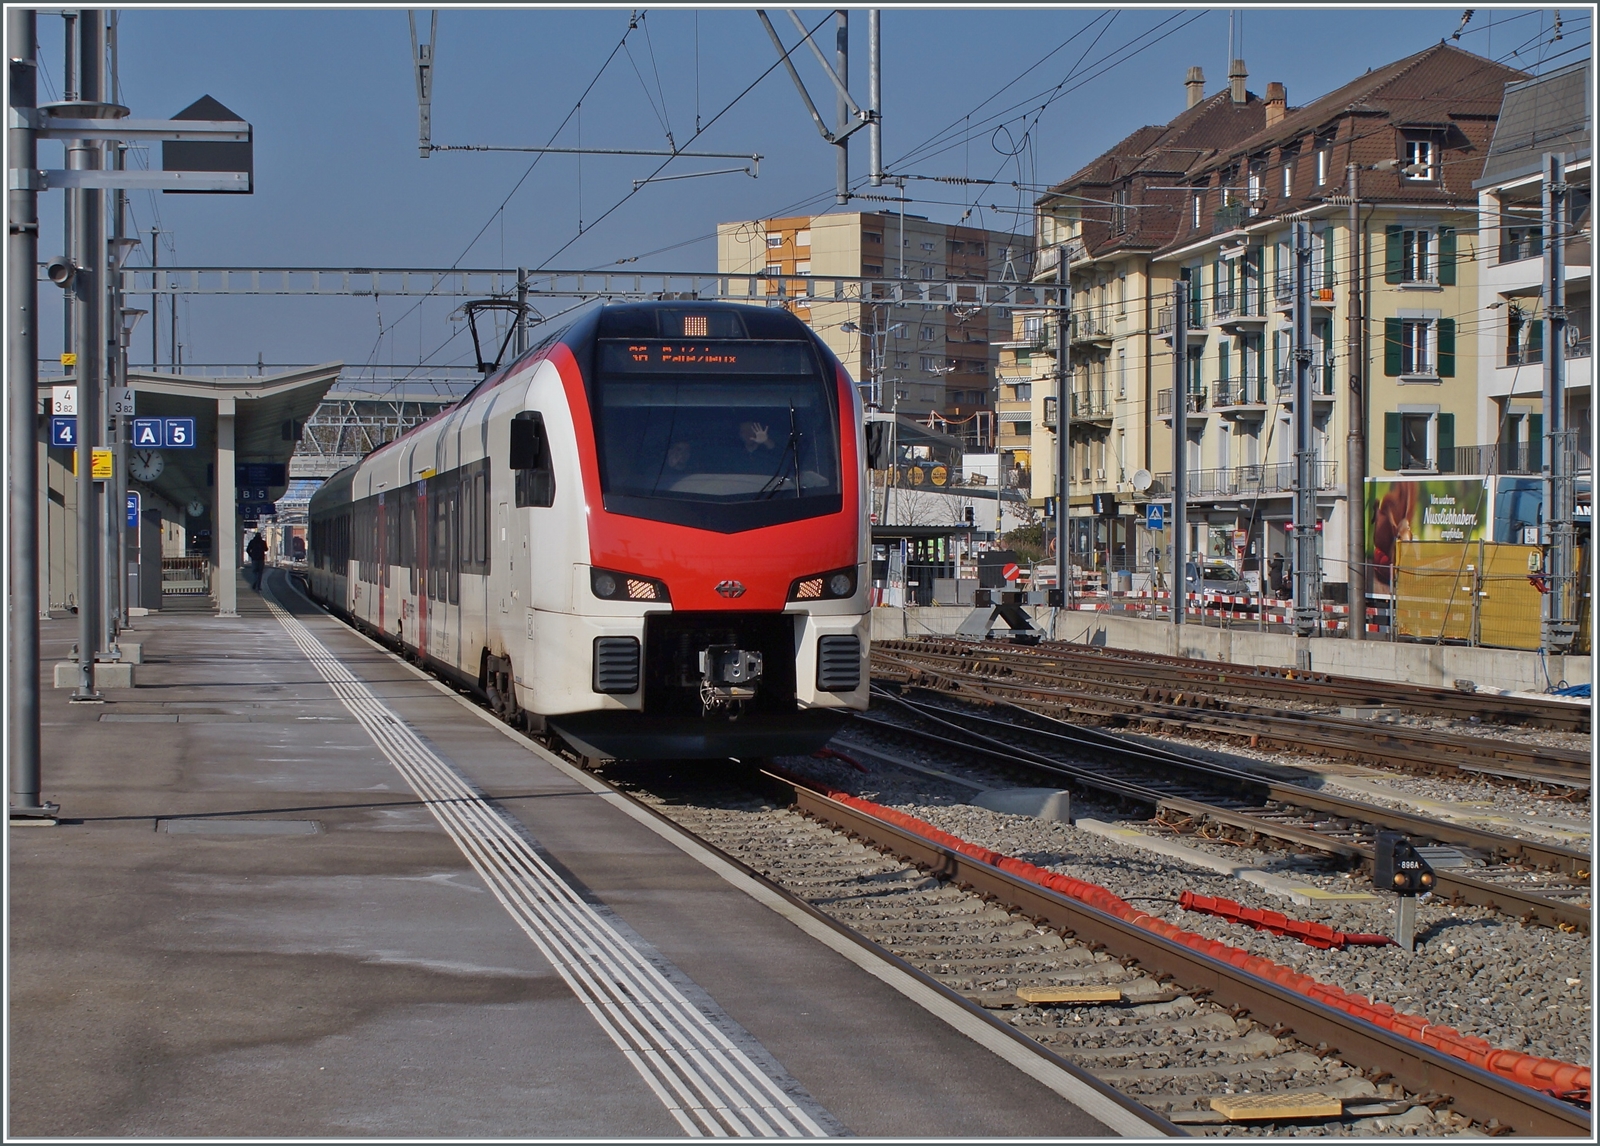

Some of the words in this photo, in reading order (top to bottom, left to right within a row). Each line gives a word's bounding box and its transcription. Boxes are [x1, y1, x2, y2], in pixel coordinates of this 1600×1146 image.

[64, 390, 71, 400] 4
[124, 390, 131, 400] 4
[55, 402, 62, 412] 3
[115, 402, 122, 412] 3
[60, 426, 73, 442] 4
[140, 427, 156, 443] A
[173, 427, 186, 443] 5
[243, 490, 250, 498] B
[258, 490, 264, 498] 5
[1430, 493, 1438, 504] Von
[1439, 494, 1456, 504] wahren
[1401, 860, 1420, 869] 896A
